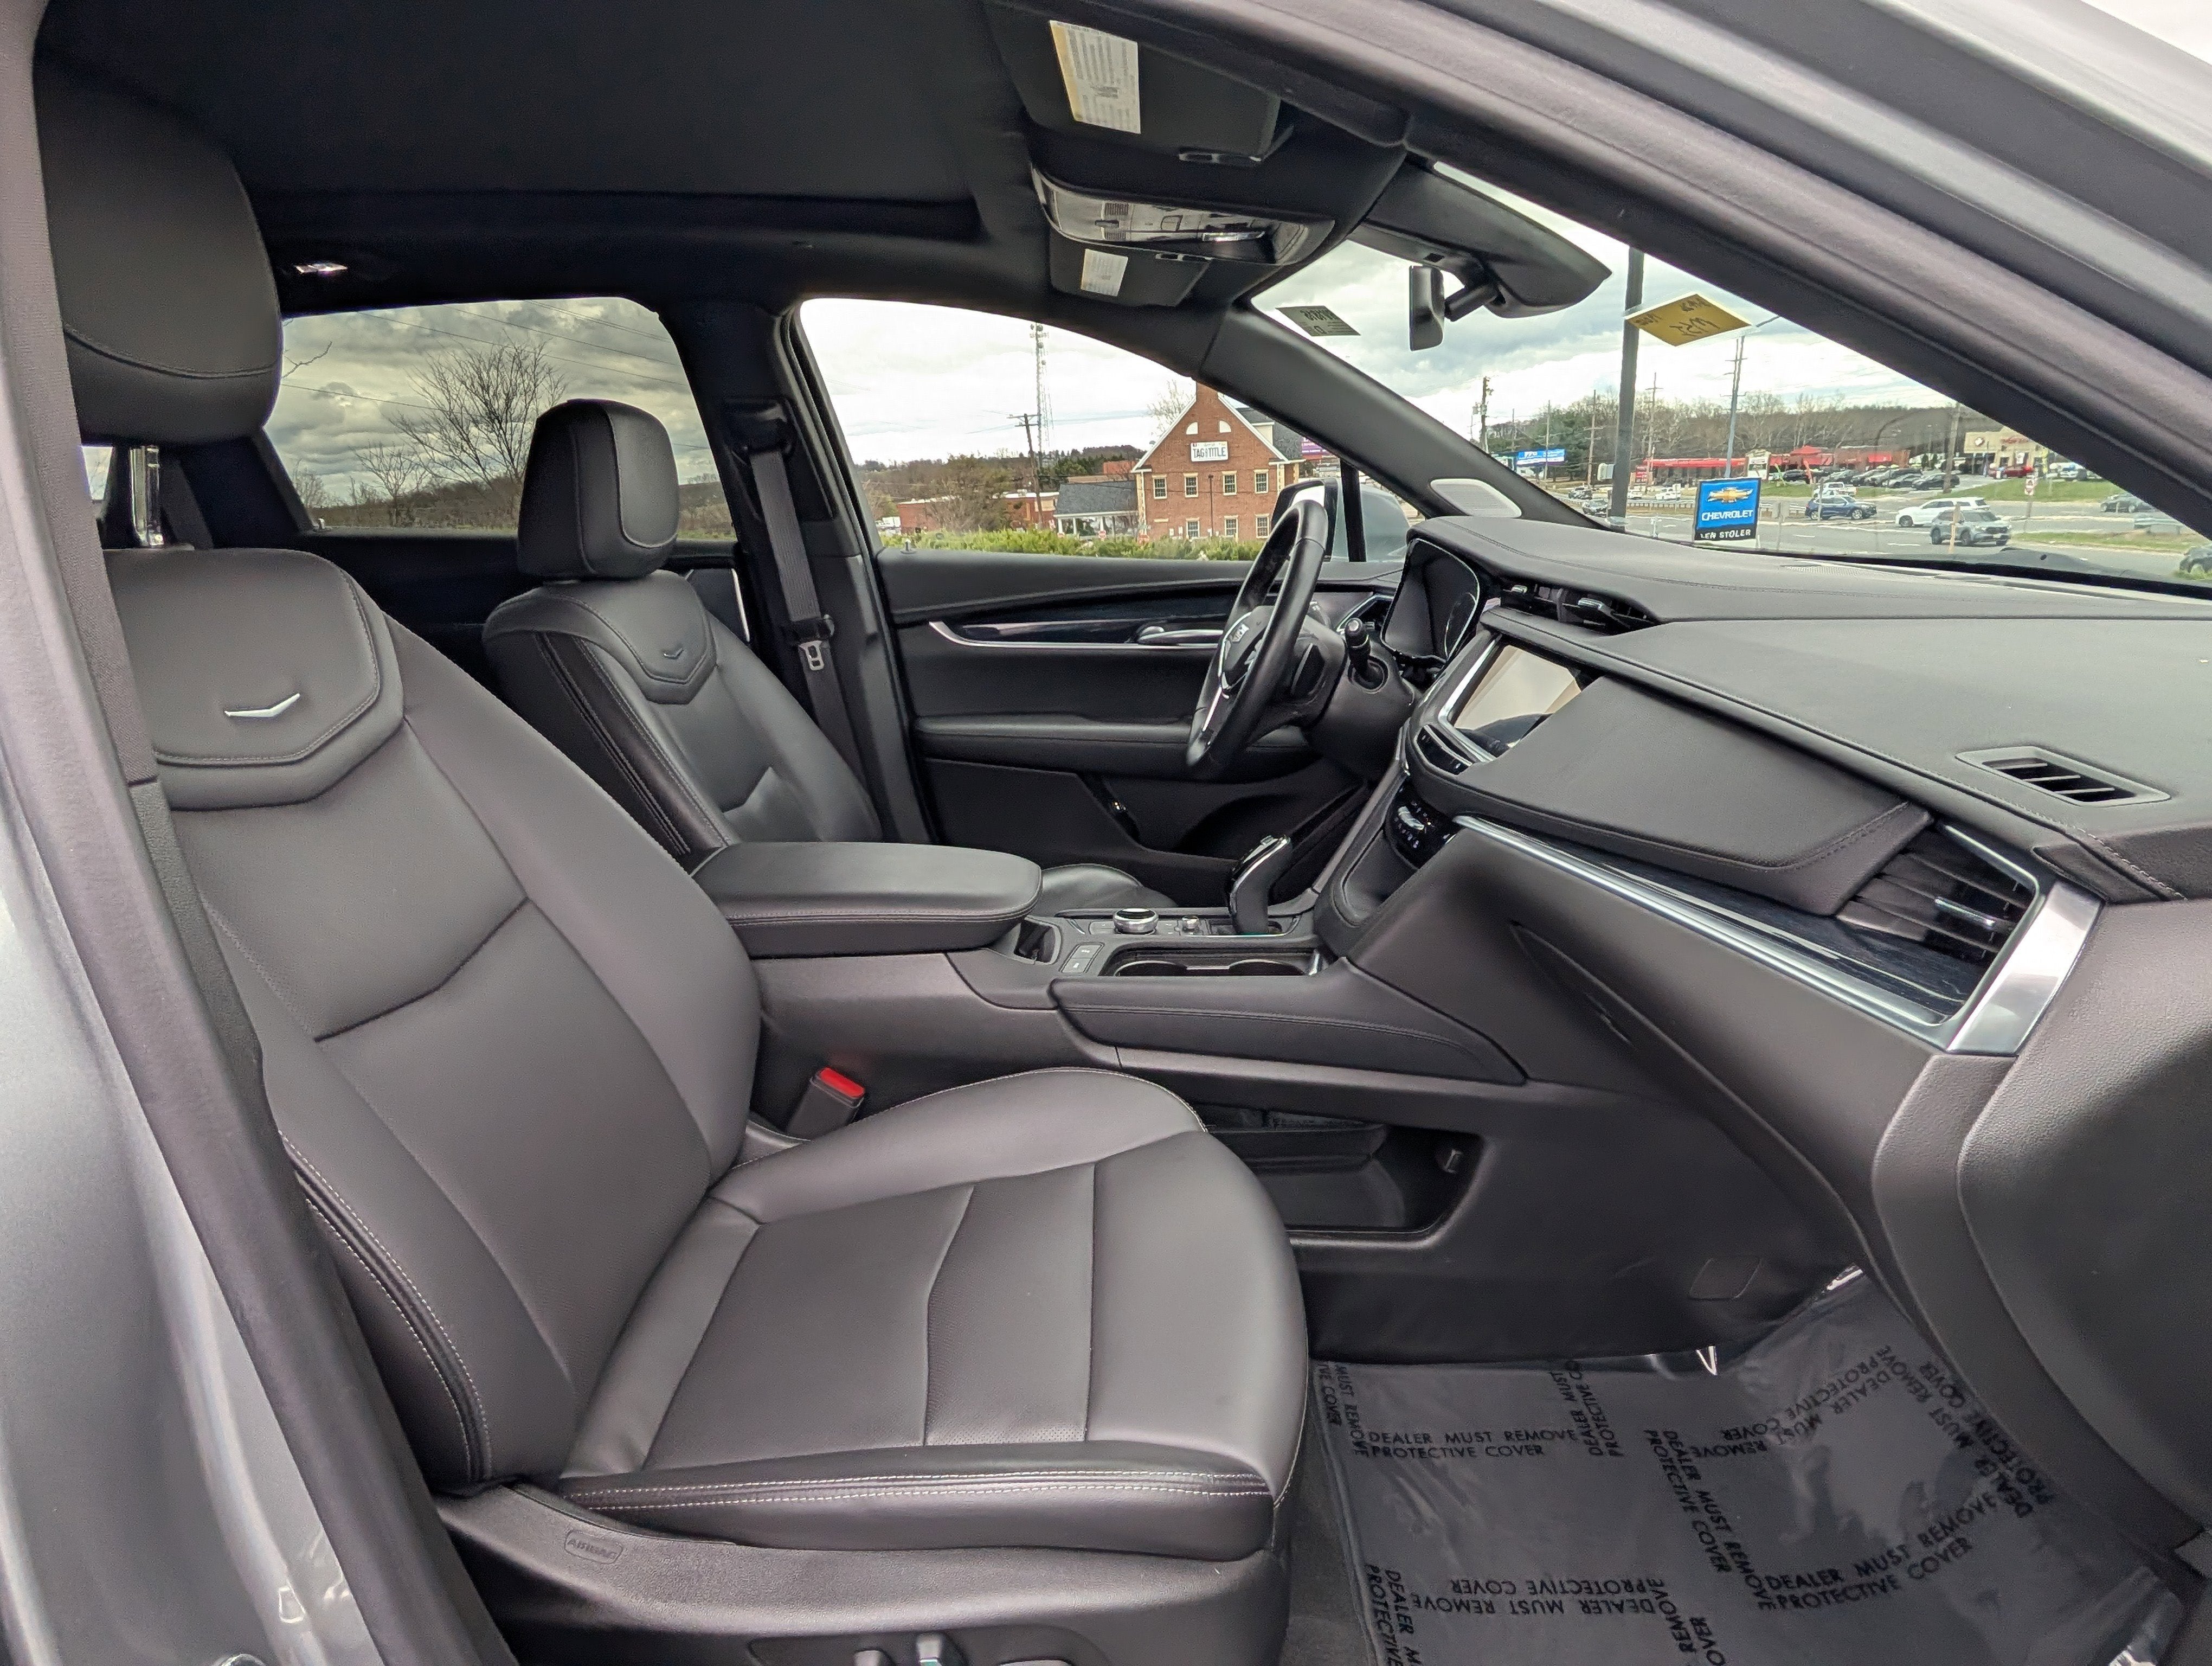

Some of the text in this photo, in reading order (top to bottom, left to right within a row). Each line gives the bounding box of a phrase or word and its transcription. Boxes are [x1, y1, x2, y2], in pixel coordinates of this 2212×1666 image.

[1701, 509, 1754, 521] CHEVROLET
[1719, 529, 1751, 539] STOLER
[1549, 1371, 1577, 1401] MUST
[1369, 1430, 1577, 1444] DEALER MUST REMOVE
[1570, 1410, 1603, 1456] DEALER
[1576, 1384, 1624, 1457] PROTECTIVE
[1720, 1418, 1780, 1440] COVER
[1371, 1445, 1544, 1458] PROTECTIVE COVER
[1689, 1440, 1767, 1457] REMOVE
[1643, 1430, 1732, 1573] PROTECTIVE COVER
[1695, 1490, 1732, 1532] MUST
[1724, 1542, 1777, 1610] REMOVE
[1765, 1492, 1997, 1590] DEALER MUST REMOVE
[1450, 1579, 1647, 1595] PROTECTIVE COVER
[1776, 1537, 1973, 1610] PROTECTIVE COVER
[1364, 1563, 1404, 1666] PROTECTIVE
[1385, 1569, 1414, 1635] DEALER
[1411, 1592, 1656, 1615] DEALER MUST REMOVE
[1646, 1578, 1696, 1653] REMOVE
[1689, 1617, 1726, 1666] OVER
